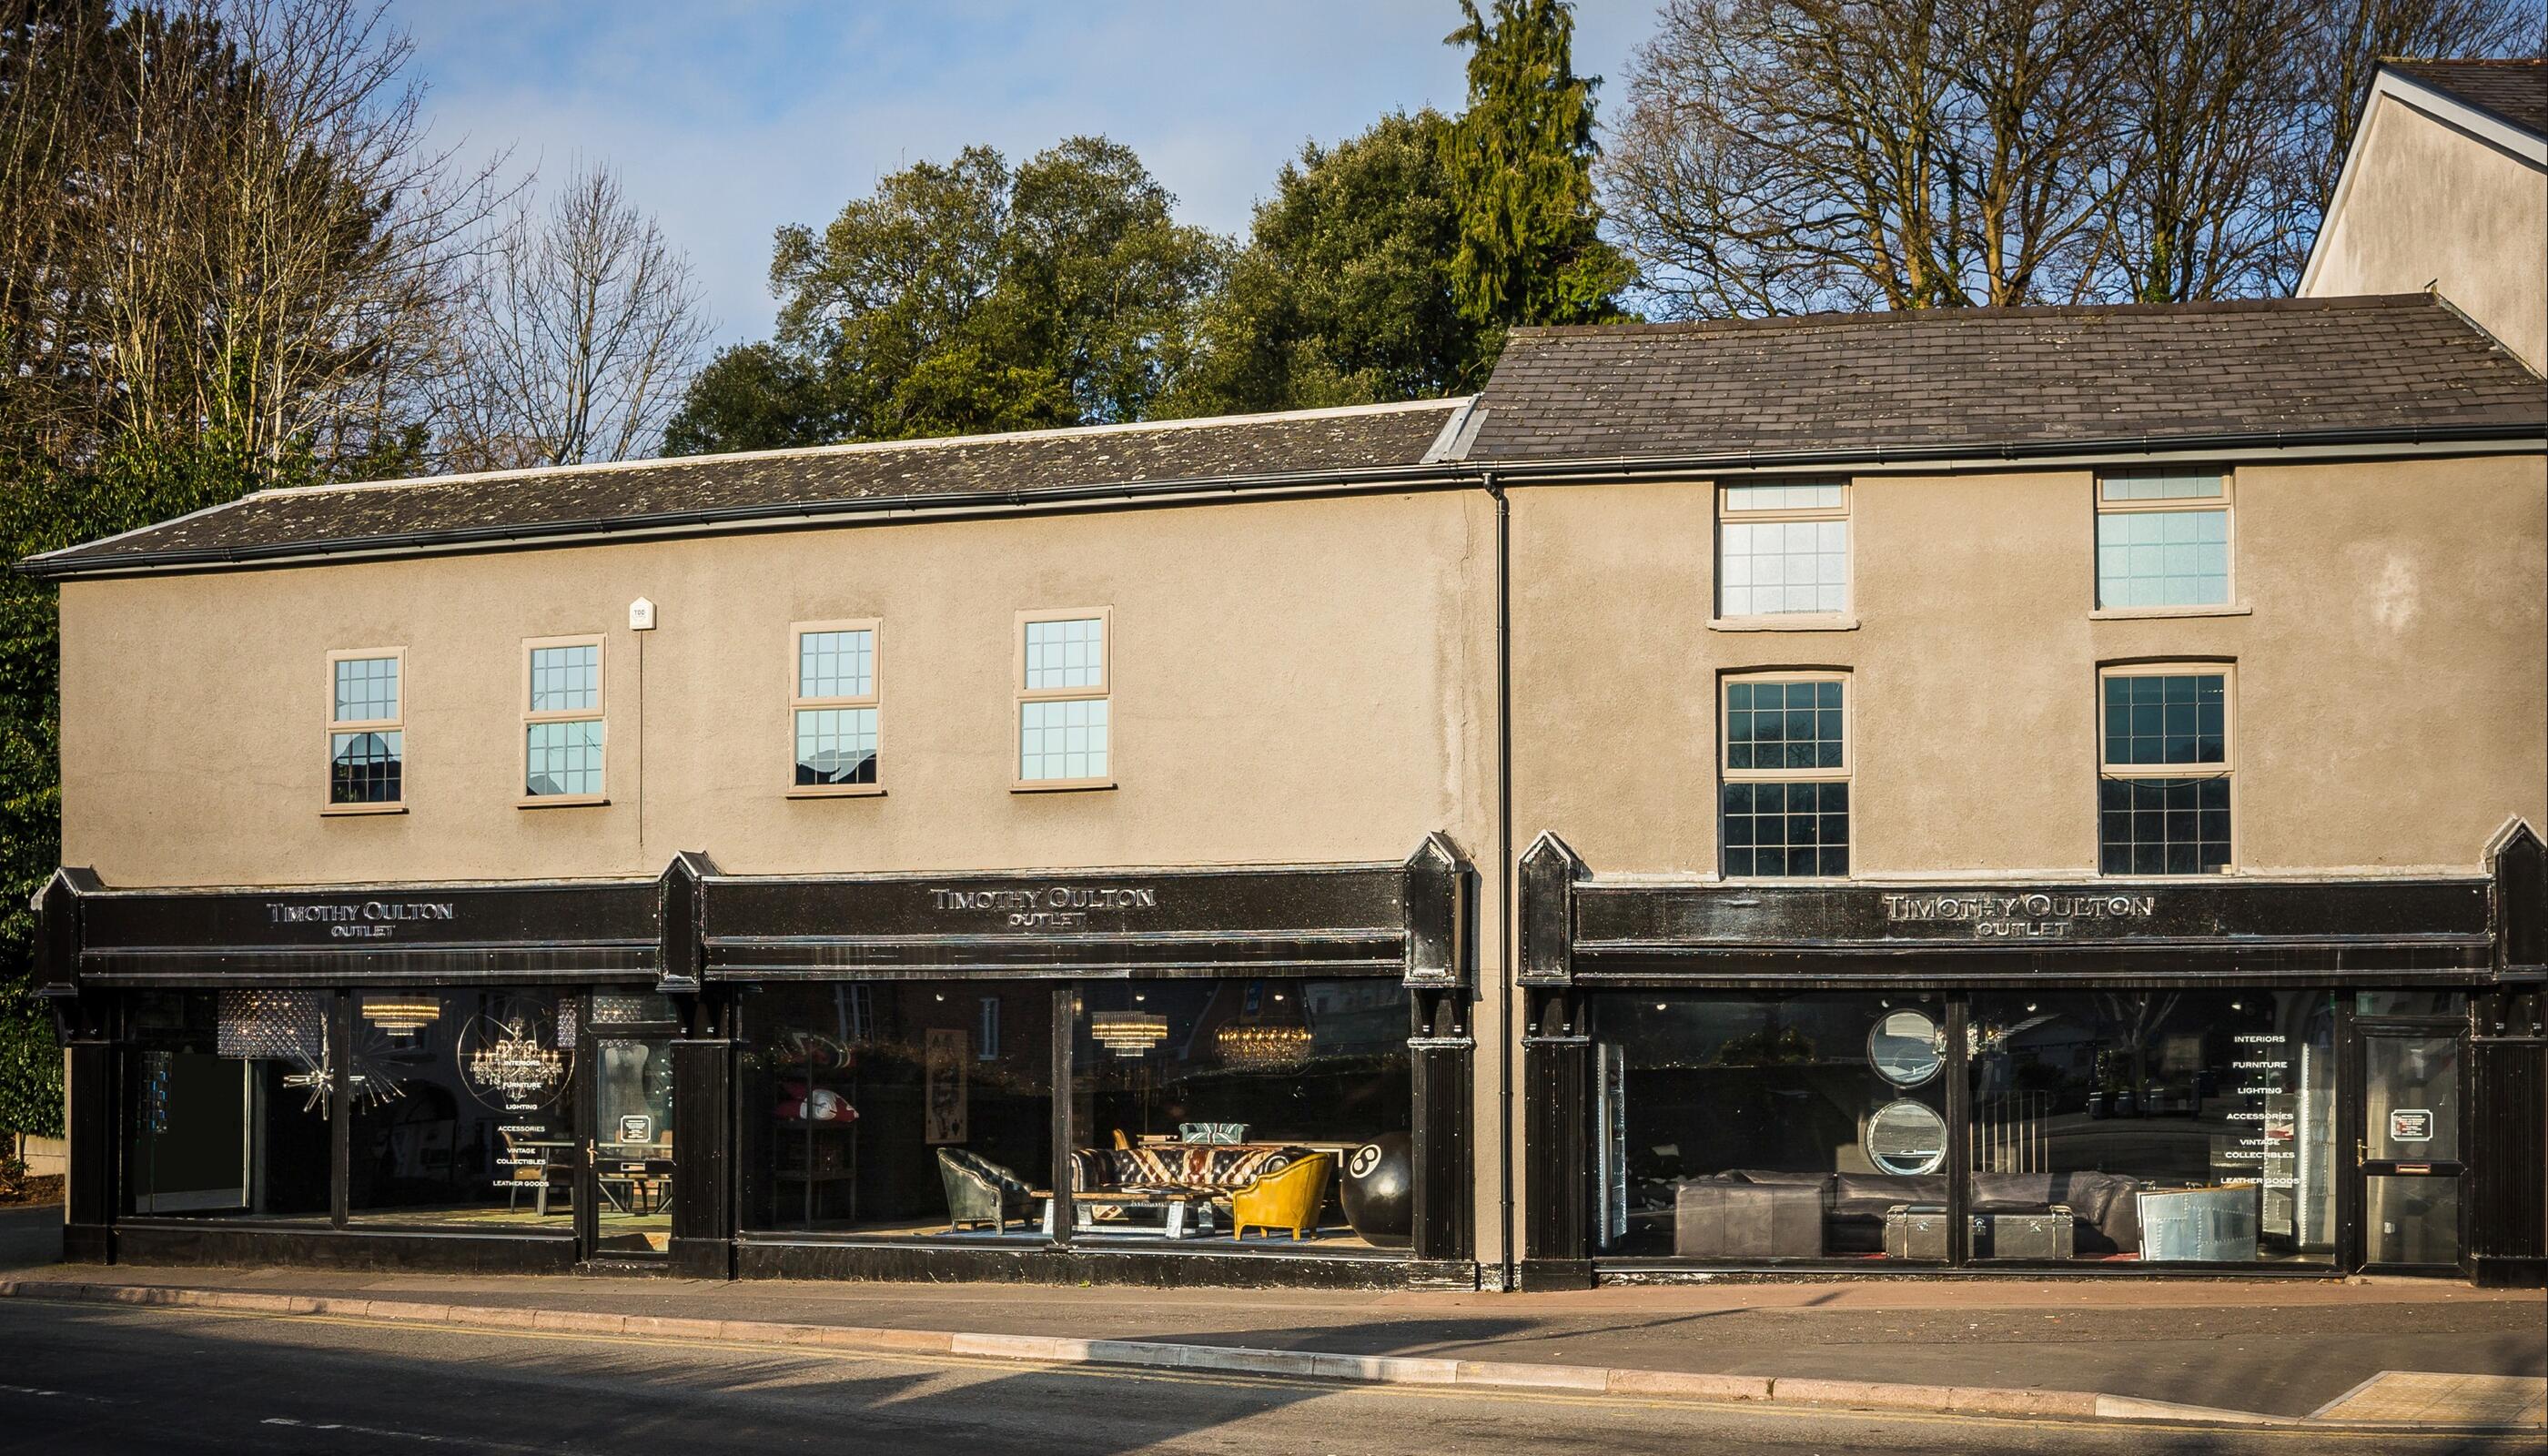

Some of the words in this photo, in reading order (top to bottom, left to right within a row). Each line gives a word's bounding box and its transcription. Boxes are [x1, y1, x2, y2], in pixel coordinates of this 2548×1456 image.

[930, 888, 1041, 909] TIMOTHY
[1049, 886, 1157, 908] OULTON
[1884, 895, 2018, 919] TIMOTHY
[2025, 894, 2154, 917] OULTON
[266, 903, 359, 923] TIMOTHY
[363, 901, 453, 921] OULTON
[1009, 913, 1086, 926] OUTLET
[331, 925, 396, 938] OUTLET
[1978, 922, 2069, 937] OUTLET
[1351, 1146, 1379, 1176] 8
